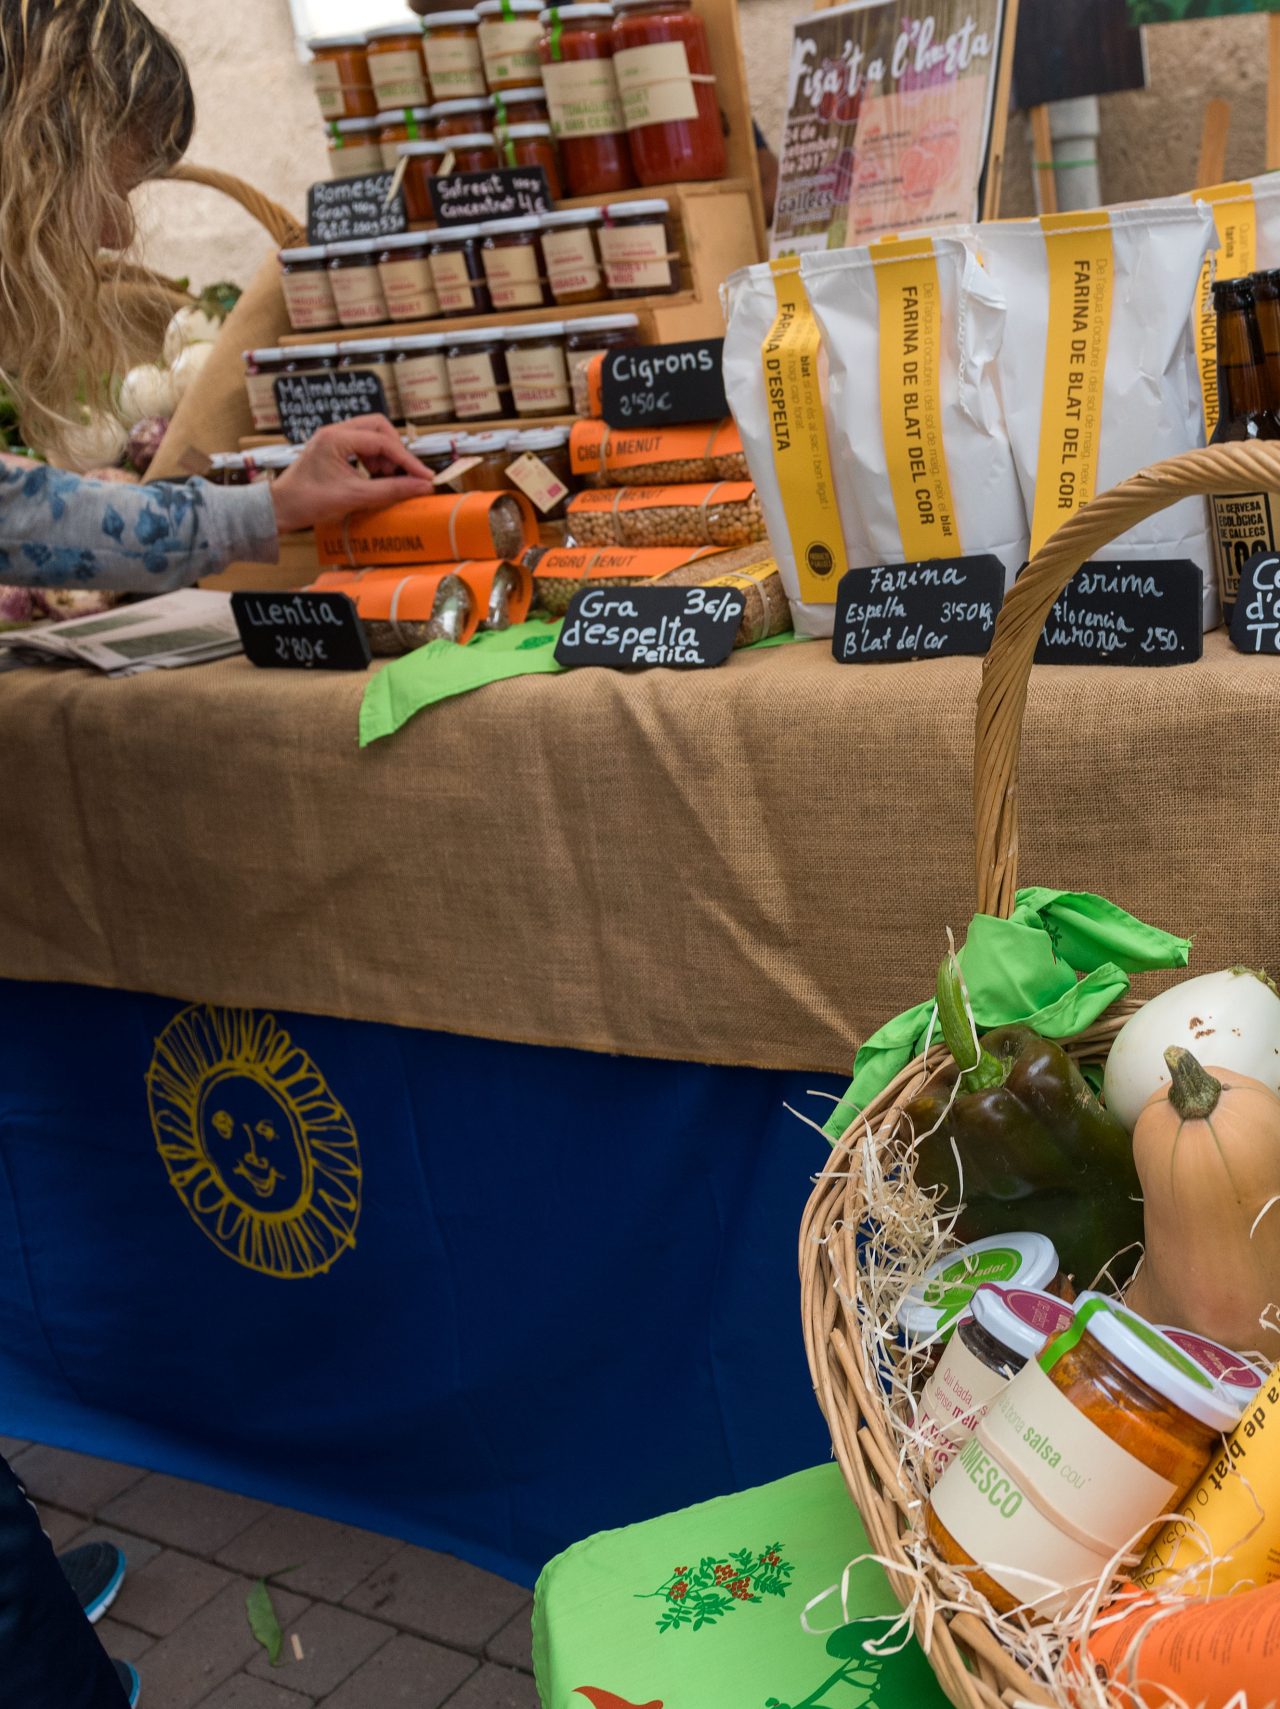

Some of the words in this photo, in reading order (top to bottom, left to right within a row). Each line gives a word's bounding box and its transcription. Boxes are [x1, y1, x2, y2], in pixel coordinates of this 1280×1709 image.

[1073, 259, 1090, 333] FARINA
[765, 302, 796, 354] FARINA
[901, 285, 919, 356] FARINA
[611, 348, 714, 388] Cigrons
[800, 355, 811, 378] blat
[1070, 340, 1086, 365] DE
[902, 361, 918, 386] DE
[766, 358, 792, 452] D'ESPELTA
[1066, 372, 1084, 421] BLAT
[903, 392, 921, 440] BLAT
[616, 436, 663, 455] MENUT
[1061, 427, 1079, 465] DEL
[907, 447, 926, 484] DEL
[914, 488, 935, 526] COR
[1057, 471, 1076, 509] COR
[1226, 501, 1261, 514] CERVESA
[940, 514, 952, 537] blat
[1228, 526, 1266, 539] GALLECS
[371, 535, 426, 553] PARDINA
[869, 562, 967, 595] Farina
[579, 589, 639, 619] Gra
[561, 614, 700, 654] d'espelta
[896, 623, 923, 651] del
[631, 644, 706, 664] Petita
[943, 1367, 956, 1388] Qui
[935, 1386, 953, 1412] sense
[1243, 1405, 1267, 1439] de
[1022, 1426, 1063, 1469] salsa
[1206, 1439, 1248, 1492] blat
